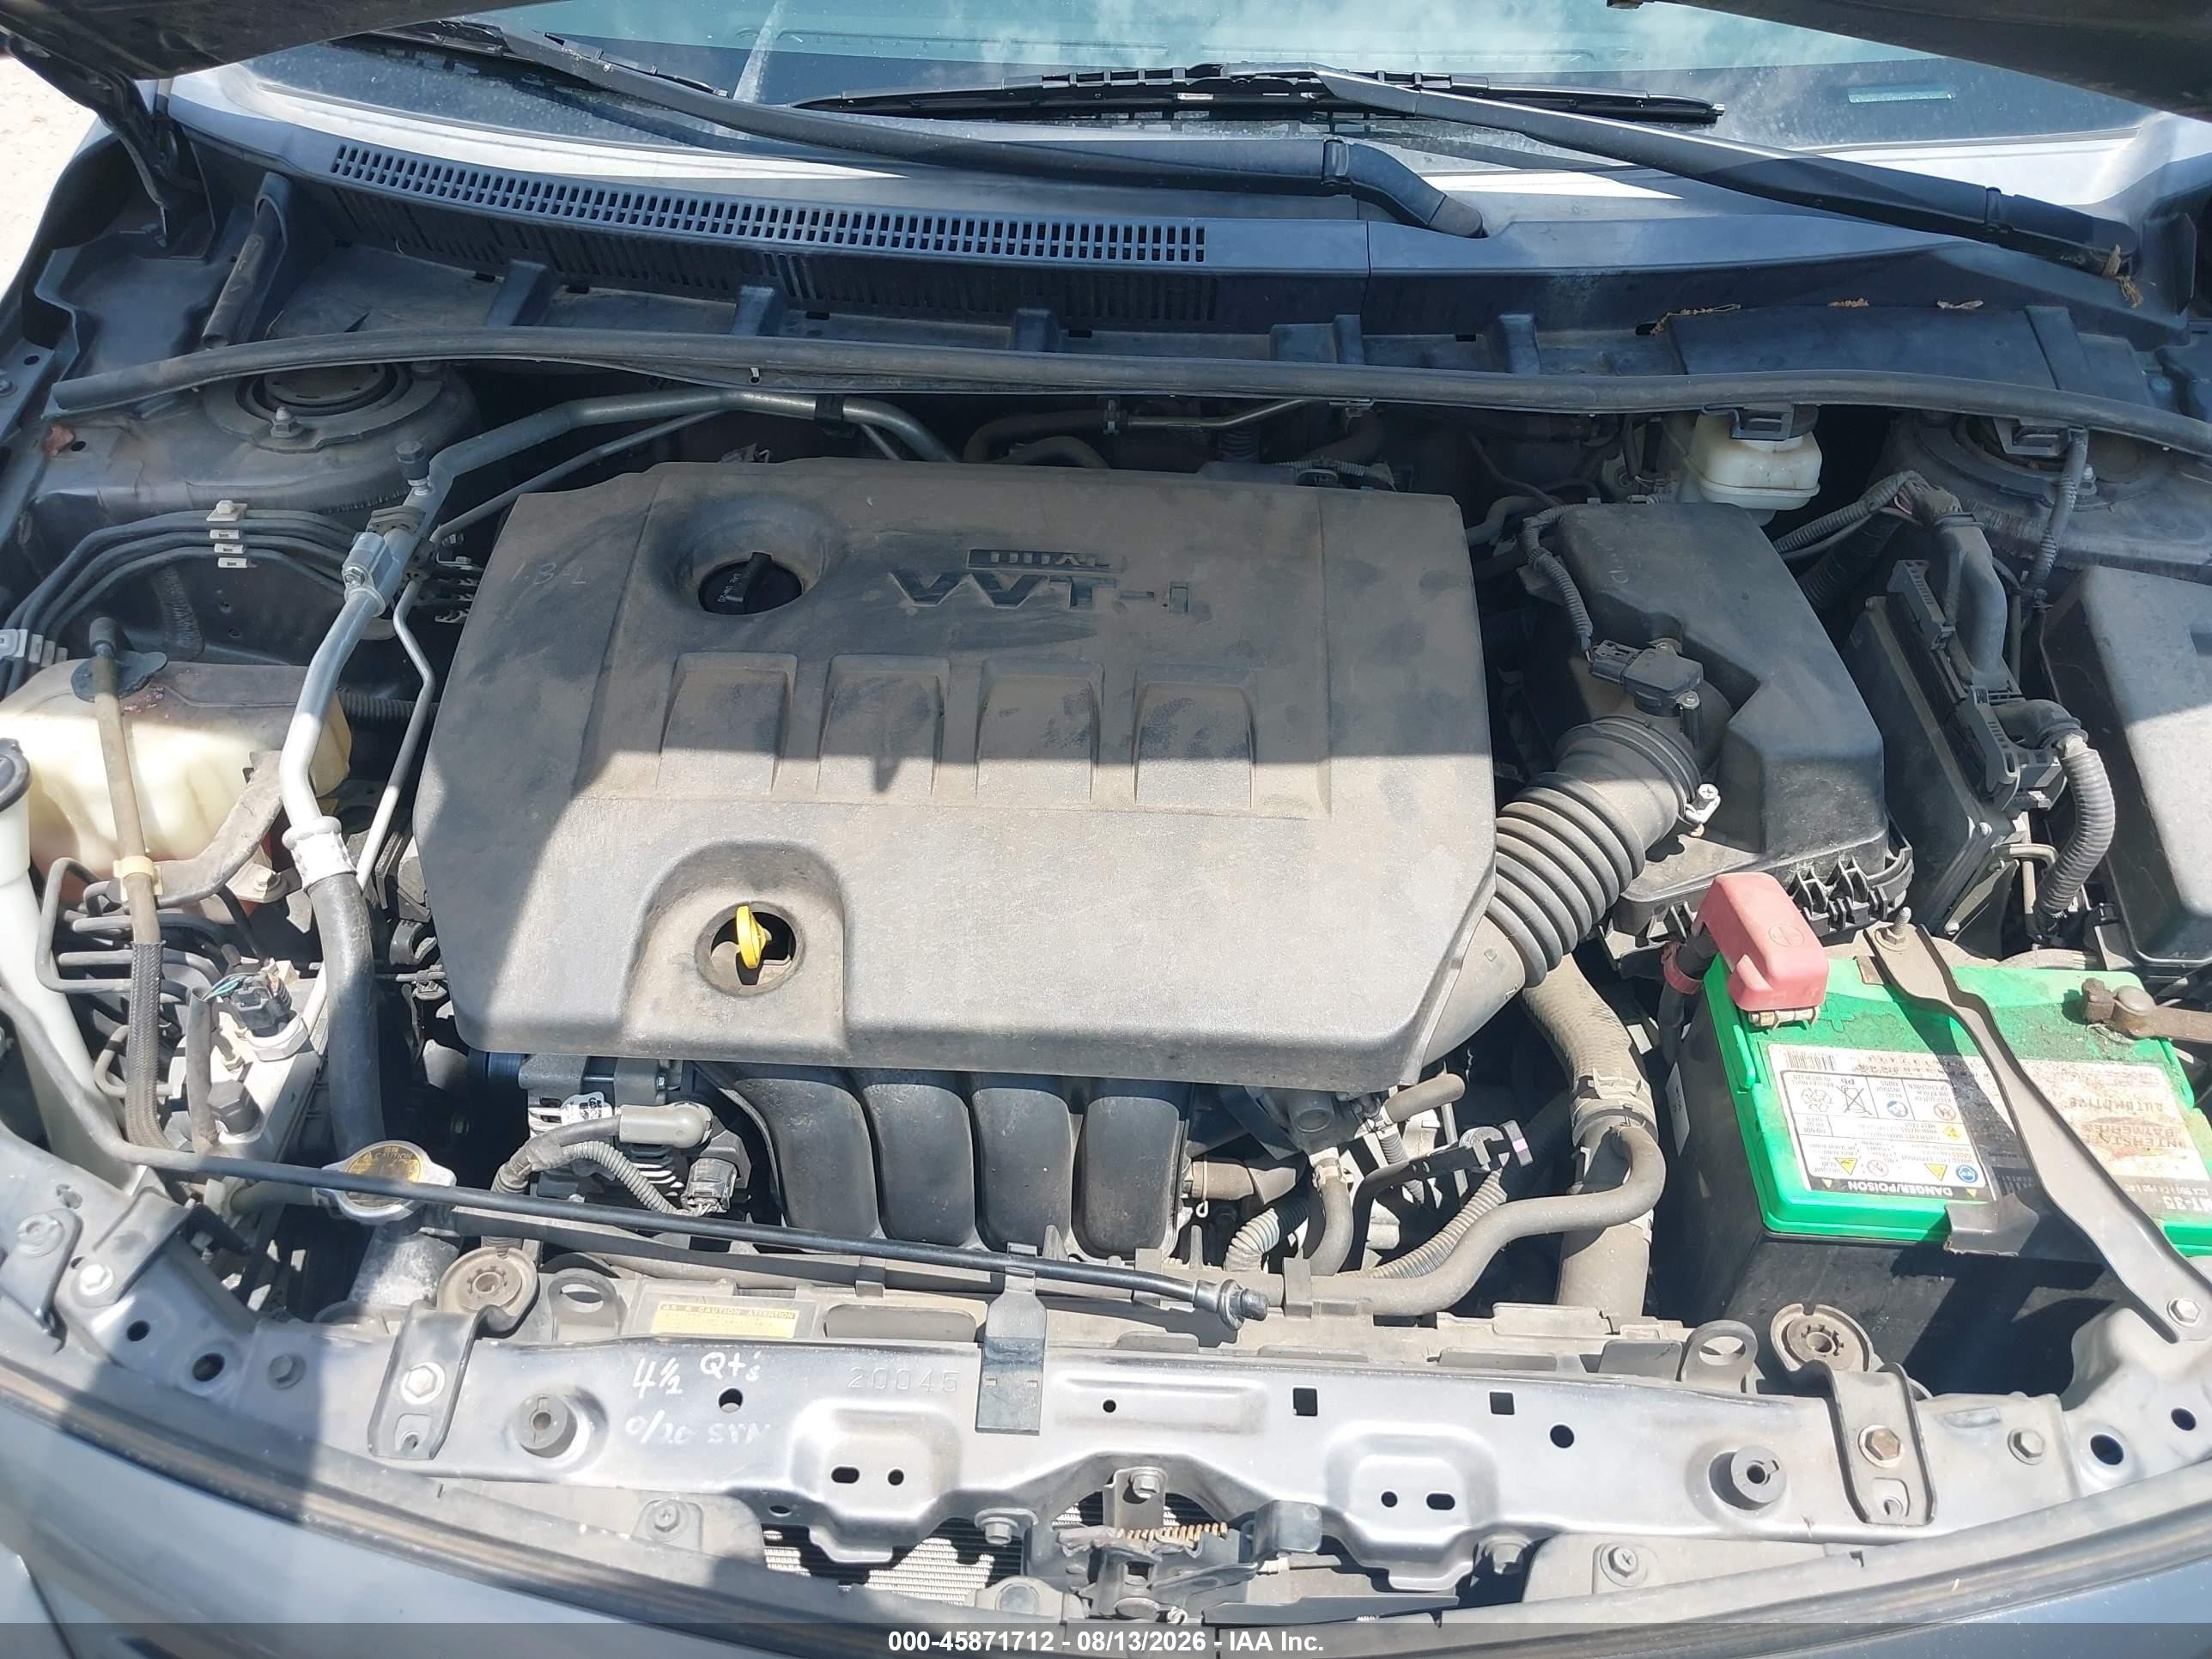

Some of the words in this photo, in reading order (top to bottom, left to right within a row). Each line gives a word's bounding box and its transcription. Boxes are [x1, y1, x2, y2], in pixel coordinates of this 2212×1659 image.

[1847, 1180, 1954, 1196] DANGER/POISON
[699, 1306, 740, 1315] CAUTION
[748, 1310, 794, 1319] ATTENTION
[847, 1366, 959, 1395] 20045
